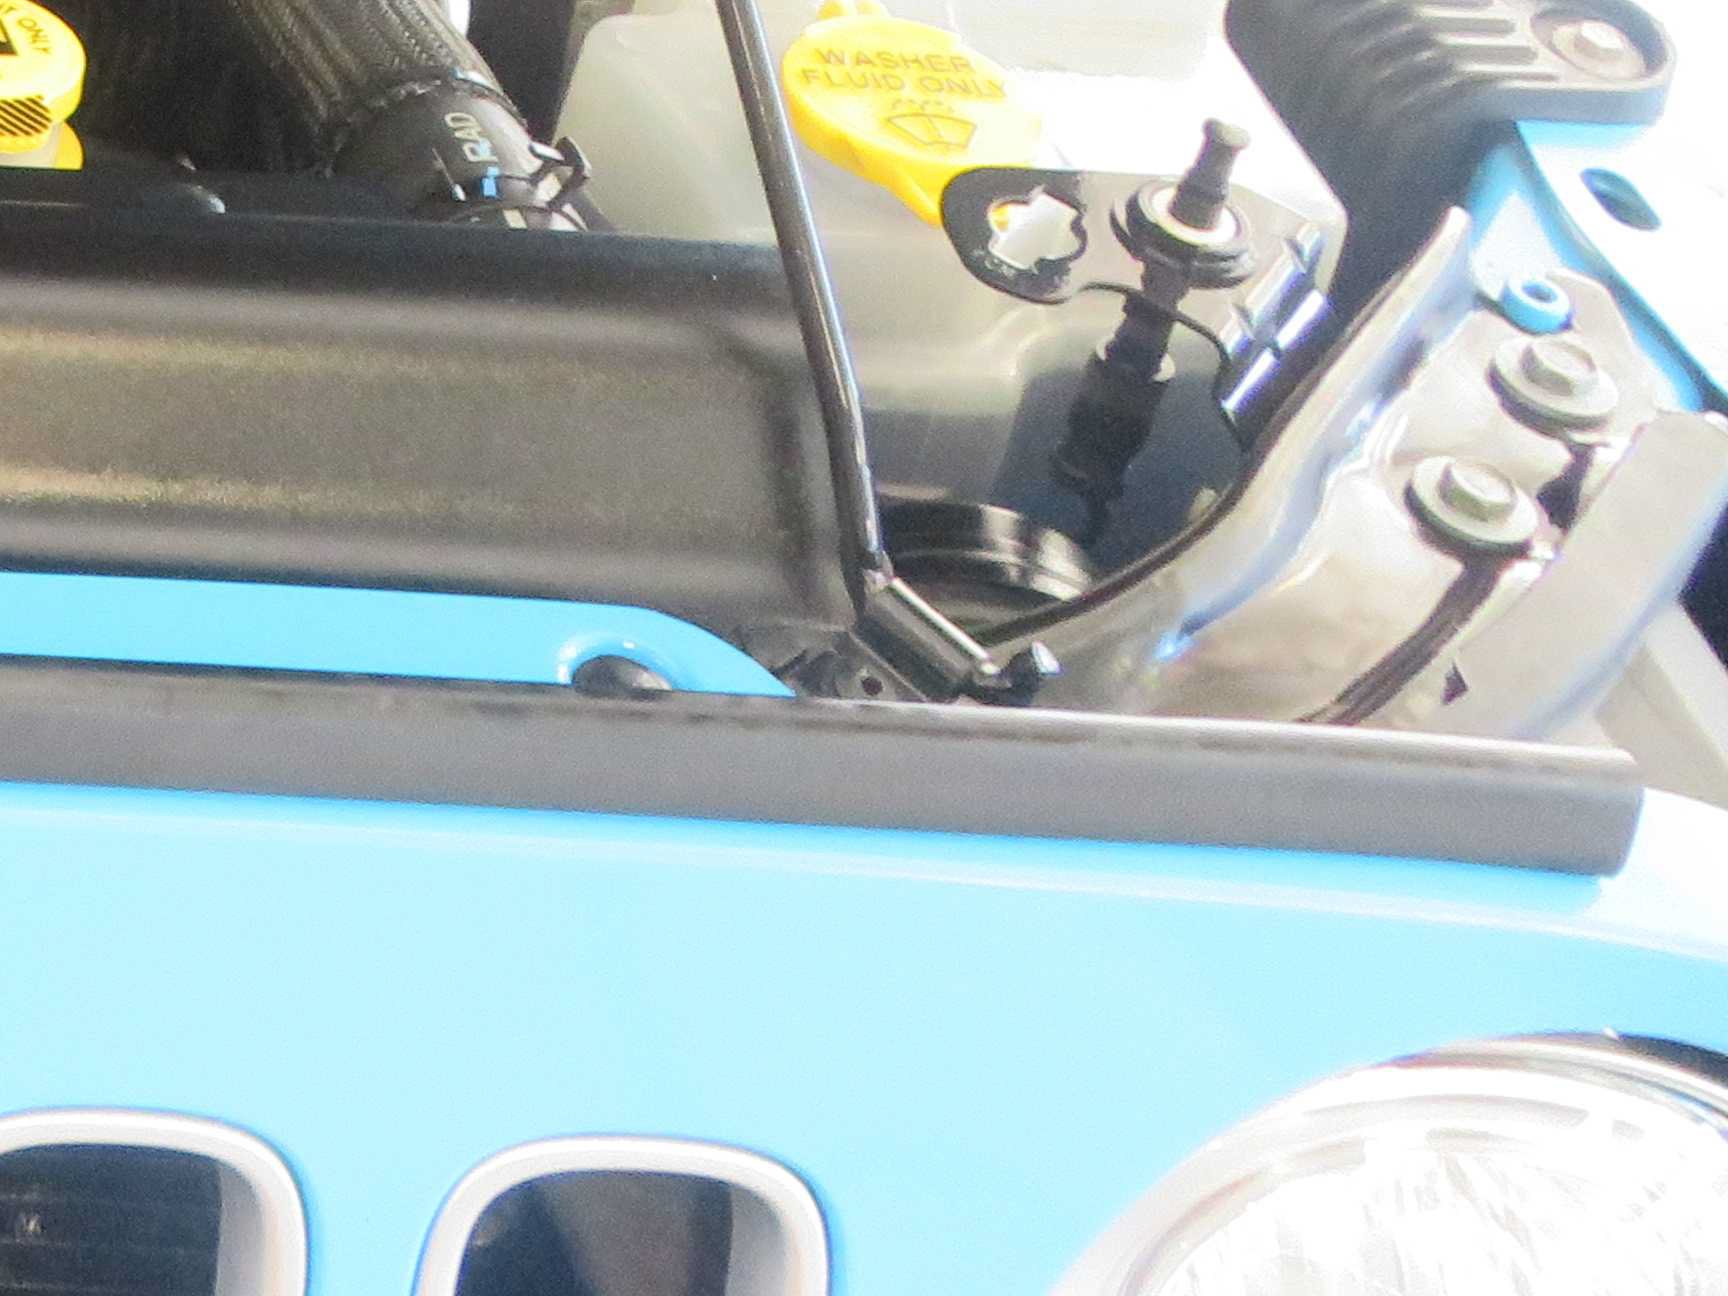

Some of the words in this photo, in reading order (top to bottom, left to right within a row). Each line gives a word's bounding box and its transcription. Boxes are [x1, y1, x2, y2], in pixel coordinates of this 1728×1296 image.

[17, 17, 53, 55] ONLY
[815, 47, 976, 74] WASHER
[800, 68, 906, 91] FLUID
[918, 75, 1008, 99] ONLY
[444, 111, 499, 163] RAD
